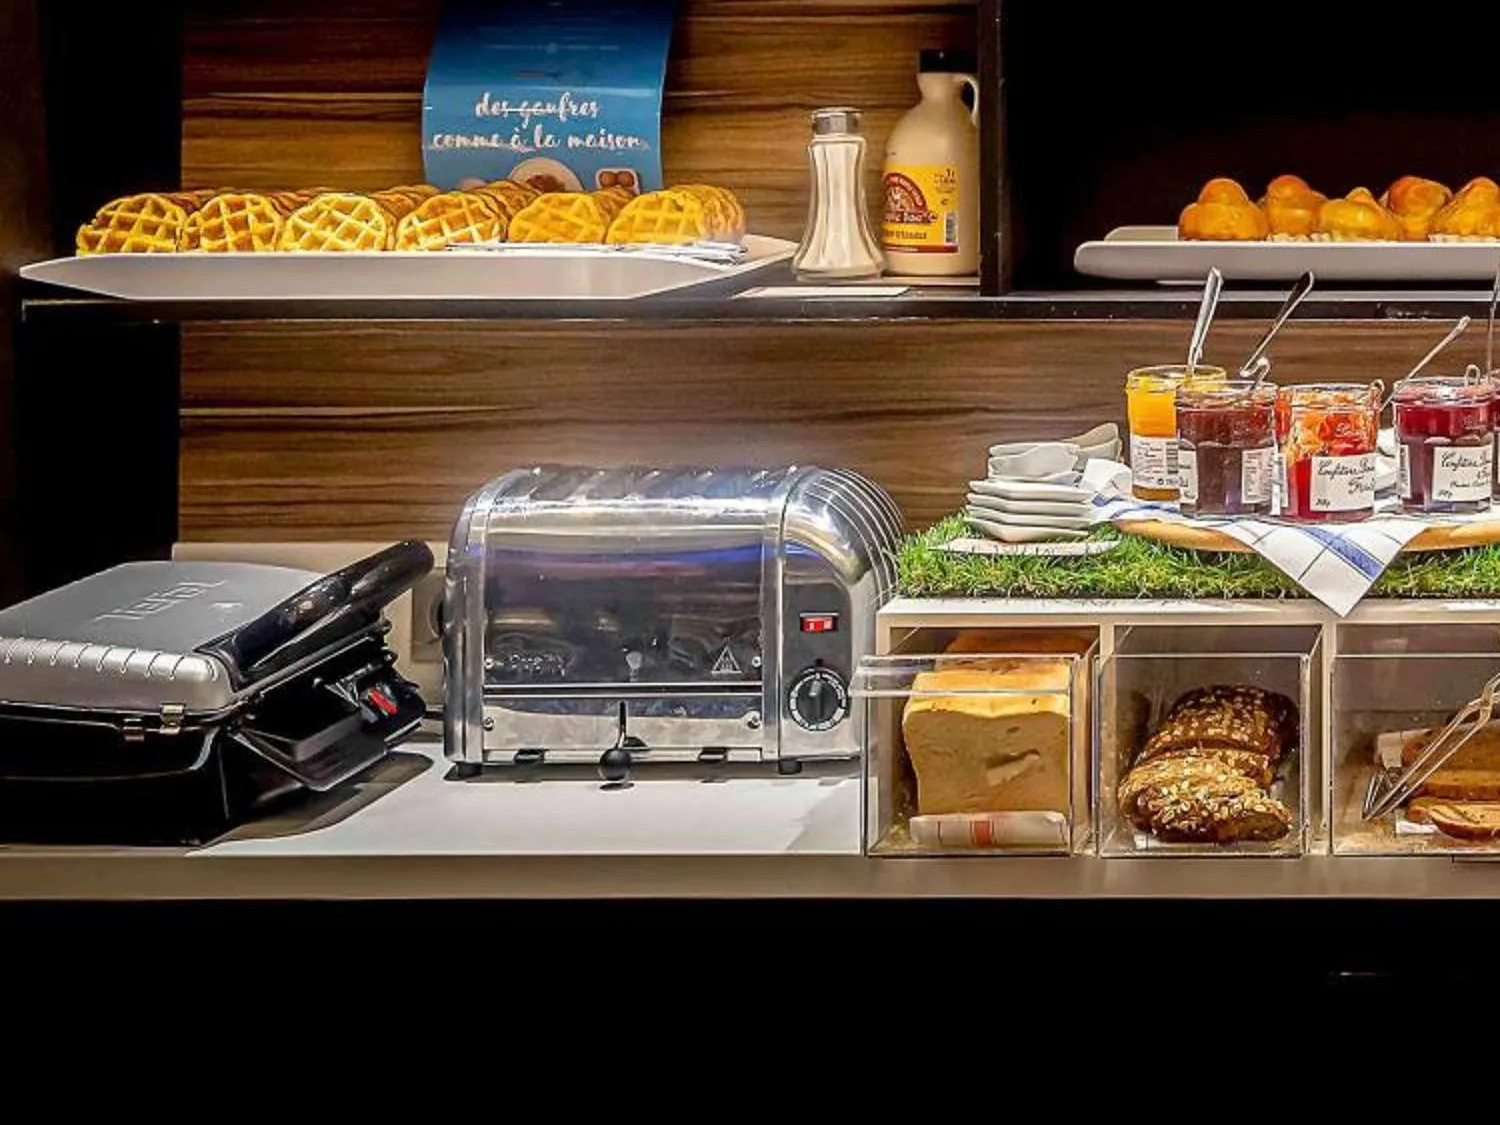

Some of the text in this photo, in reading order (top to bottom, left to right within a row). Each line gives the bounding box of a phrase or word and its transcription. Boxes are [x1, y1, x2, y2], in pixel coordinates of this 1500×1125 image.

[475, 91, 600, 129] des gaufres
[431, 123, 645, 151] comme à la maison
